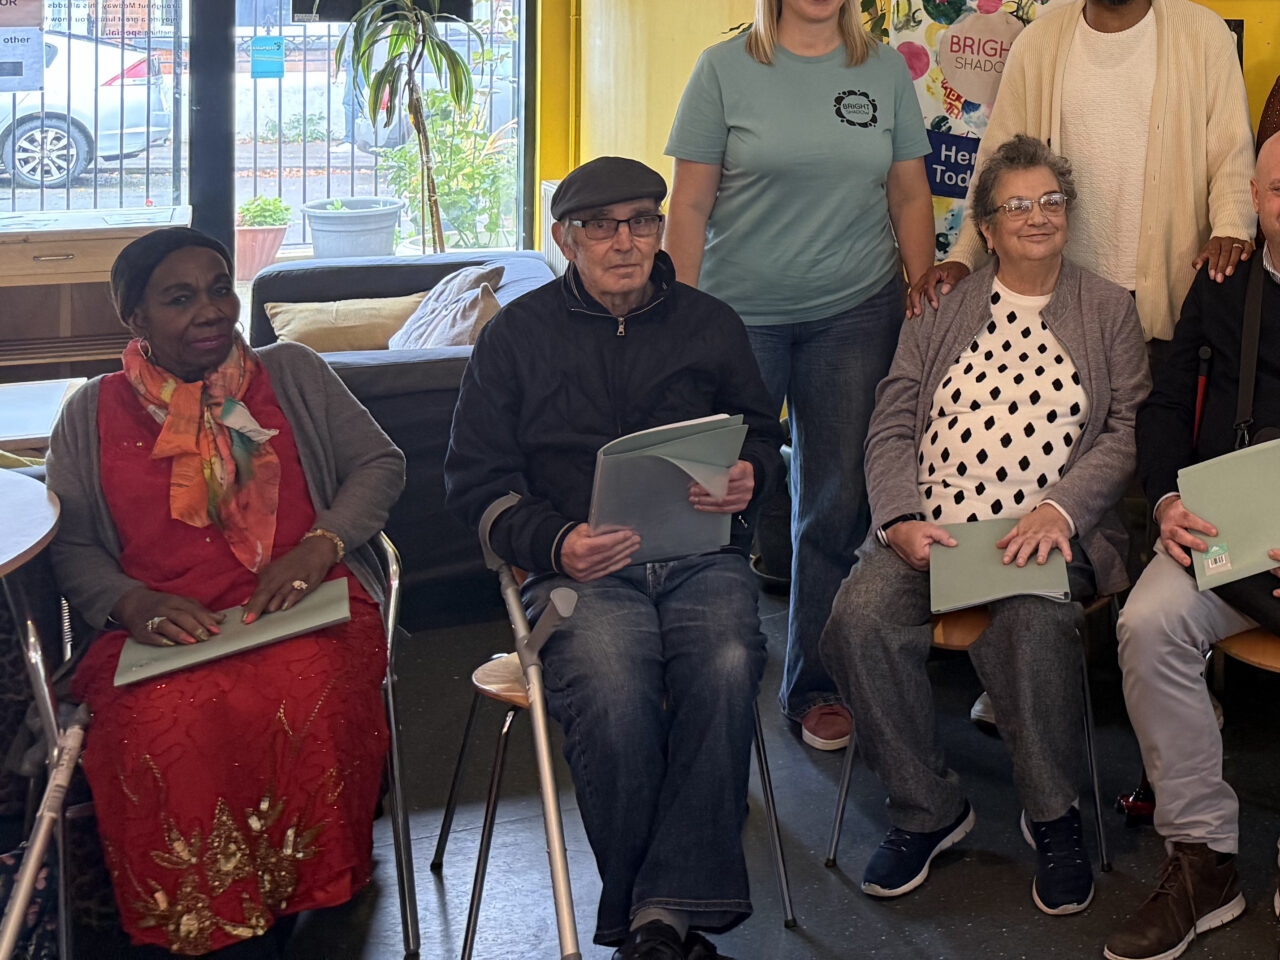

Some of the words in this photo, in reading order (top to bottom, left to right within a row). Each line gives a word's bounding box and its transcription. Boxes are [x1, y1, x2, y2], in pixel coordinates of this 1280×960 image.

[3, 36, 31, 45] other
[950, 35, 1013, 58] BRIGH
[954, 57, 1005, 73] SHADO
[941, 144, 977, 165] Her
[932, 165, 970, 187] Tod
